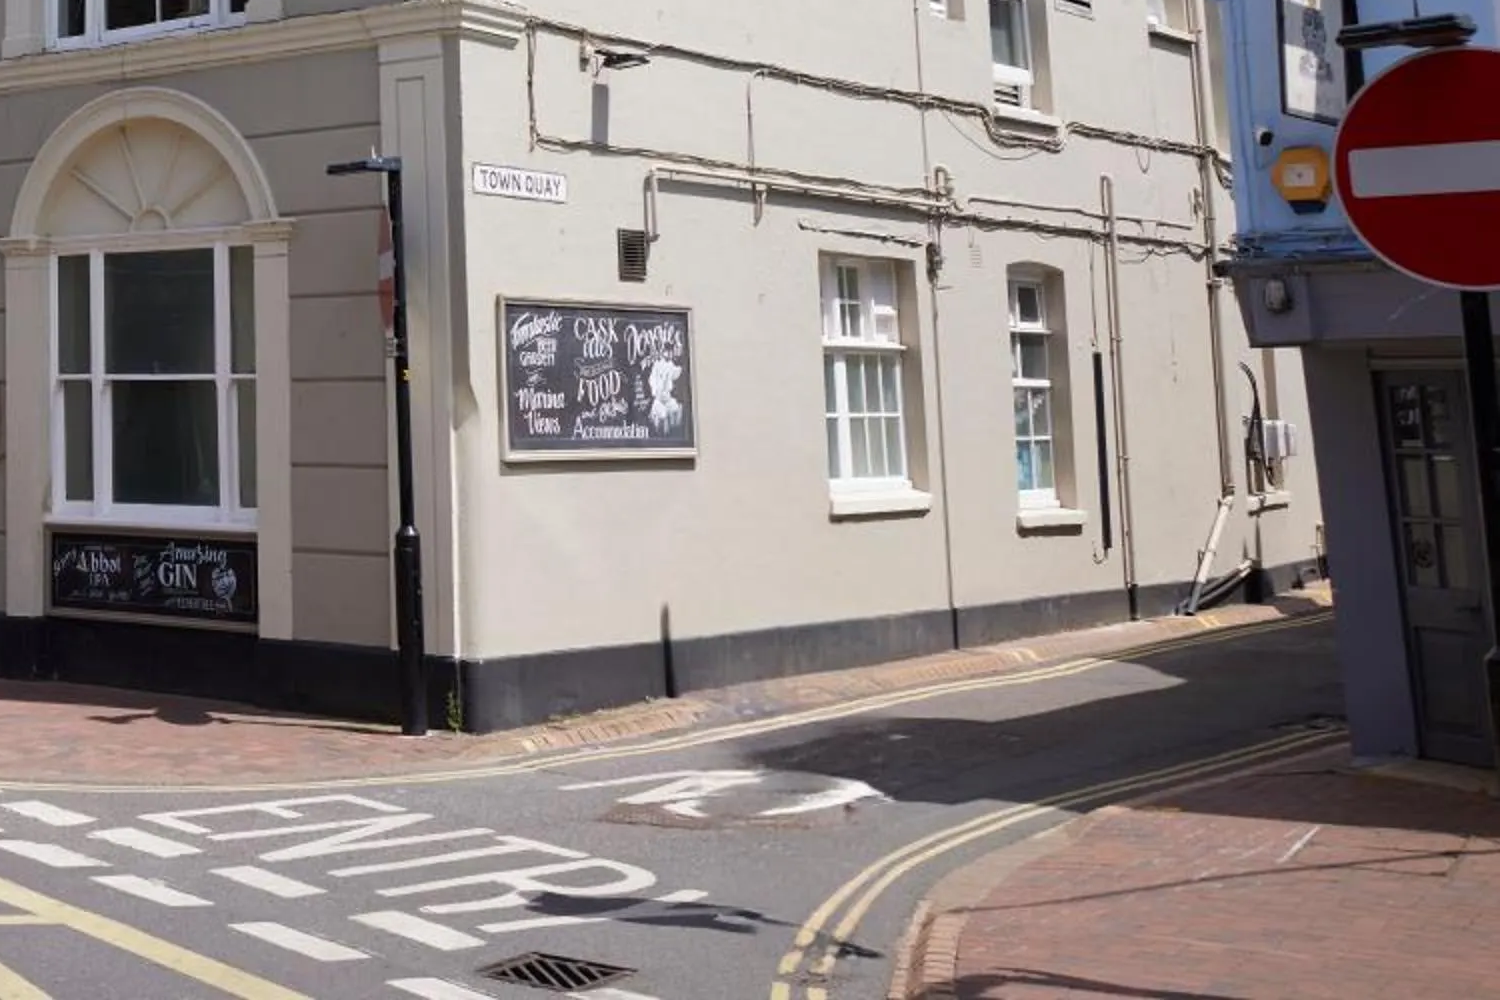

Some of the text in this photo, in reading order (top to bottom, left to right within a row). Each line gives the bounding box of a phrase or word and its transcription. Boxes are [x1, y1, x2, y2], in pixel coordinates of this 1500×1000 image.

[479, 169, 561, 197] TOWN QUAY
[573, 317, 619, 343] CASK
[157, 561, 198, 590] GIN
[138, 793, 756, 935] ENTRY
